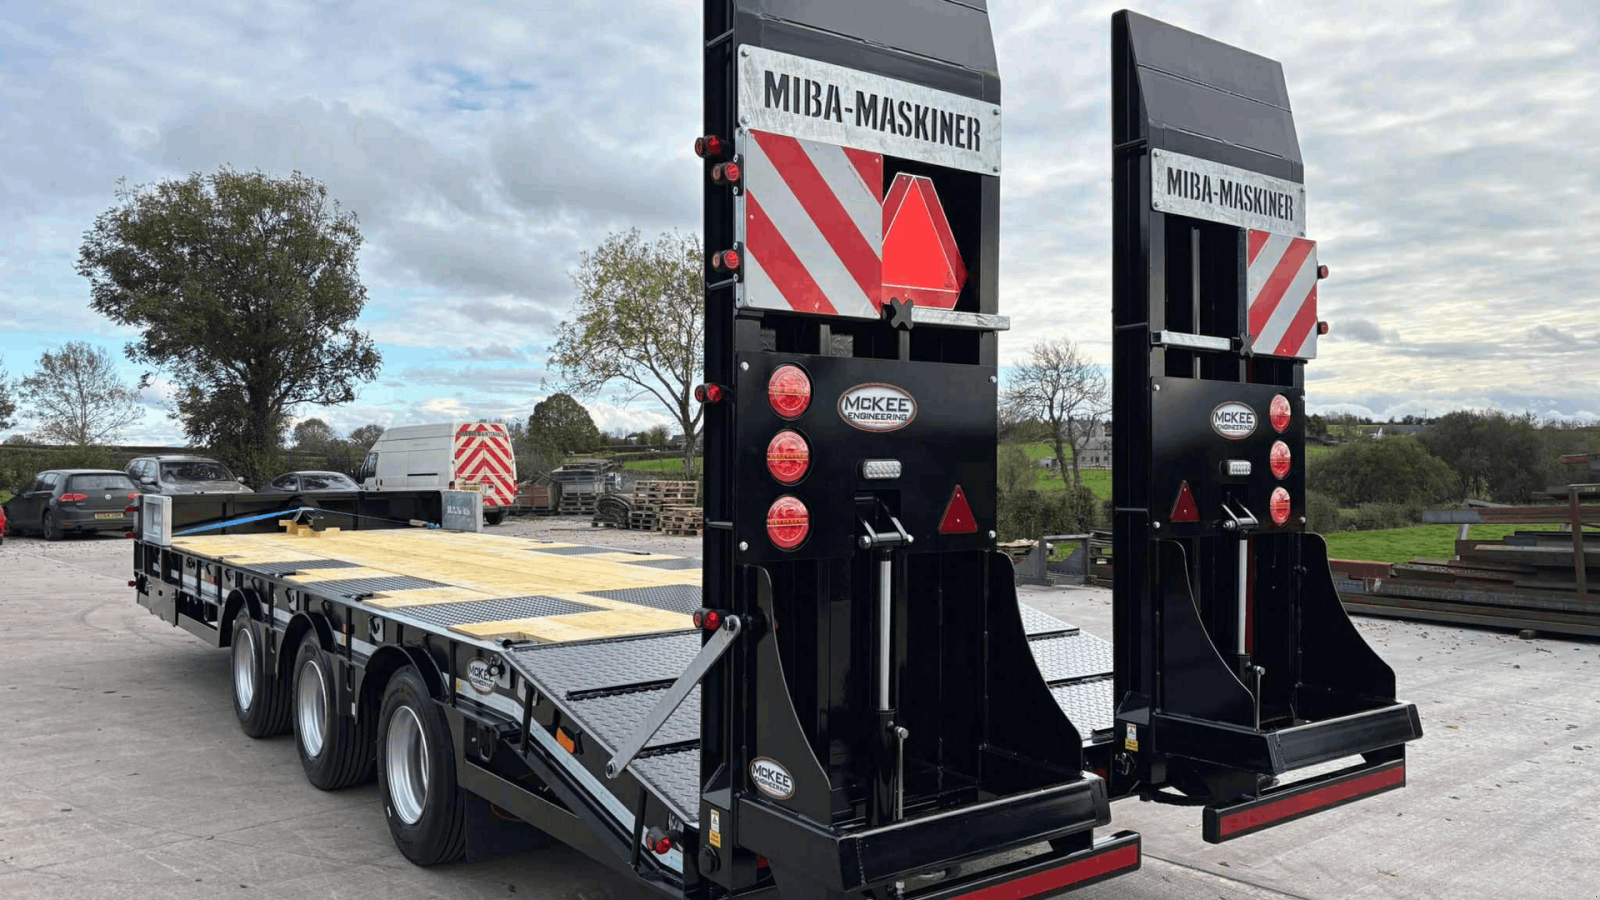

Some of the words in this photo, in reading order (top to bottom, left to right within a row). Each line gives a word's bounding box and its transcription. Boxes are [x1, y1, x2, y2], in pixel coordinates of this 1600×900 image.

[763, 70, 981, 152] MIBA-MASKINER
[1167, 166, 1293, 221] MIBA-MASKINER
[847, 412, 908, 421] ENGINEERING
